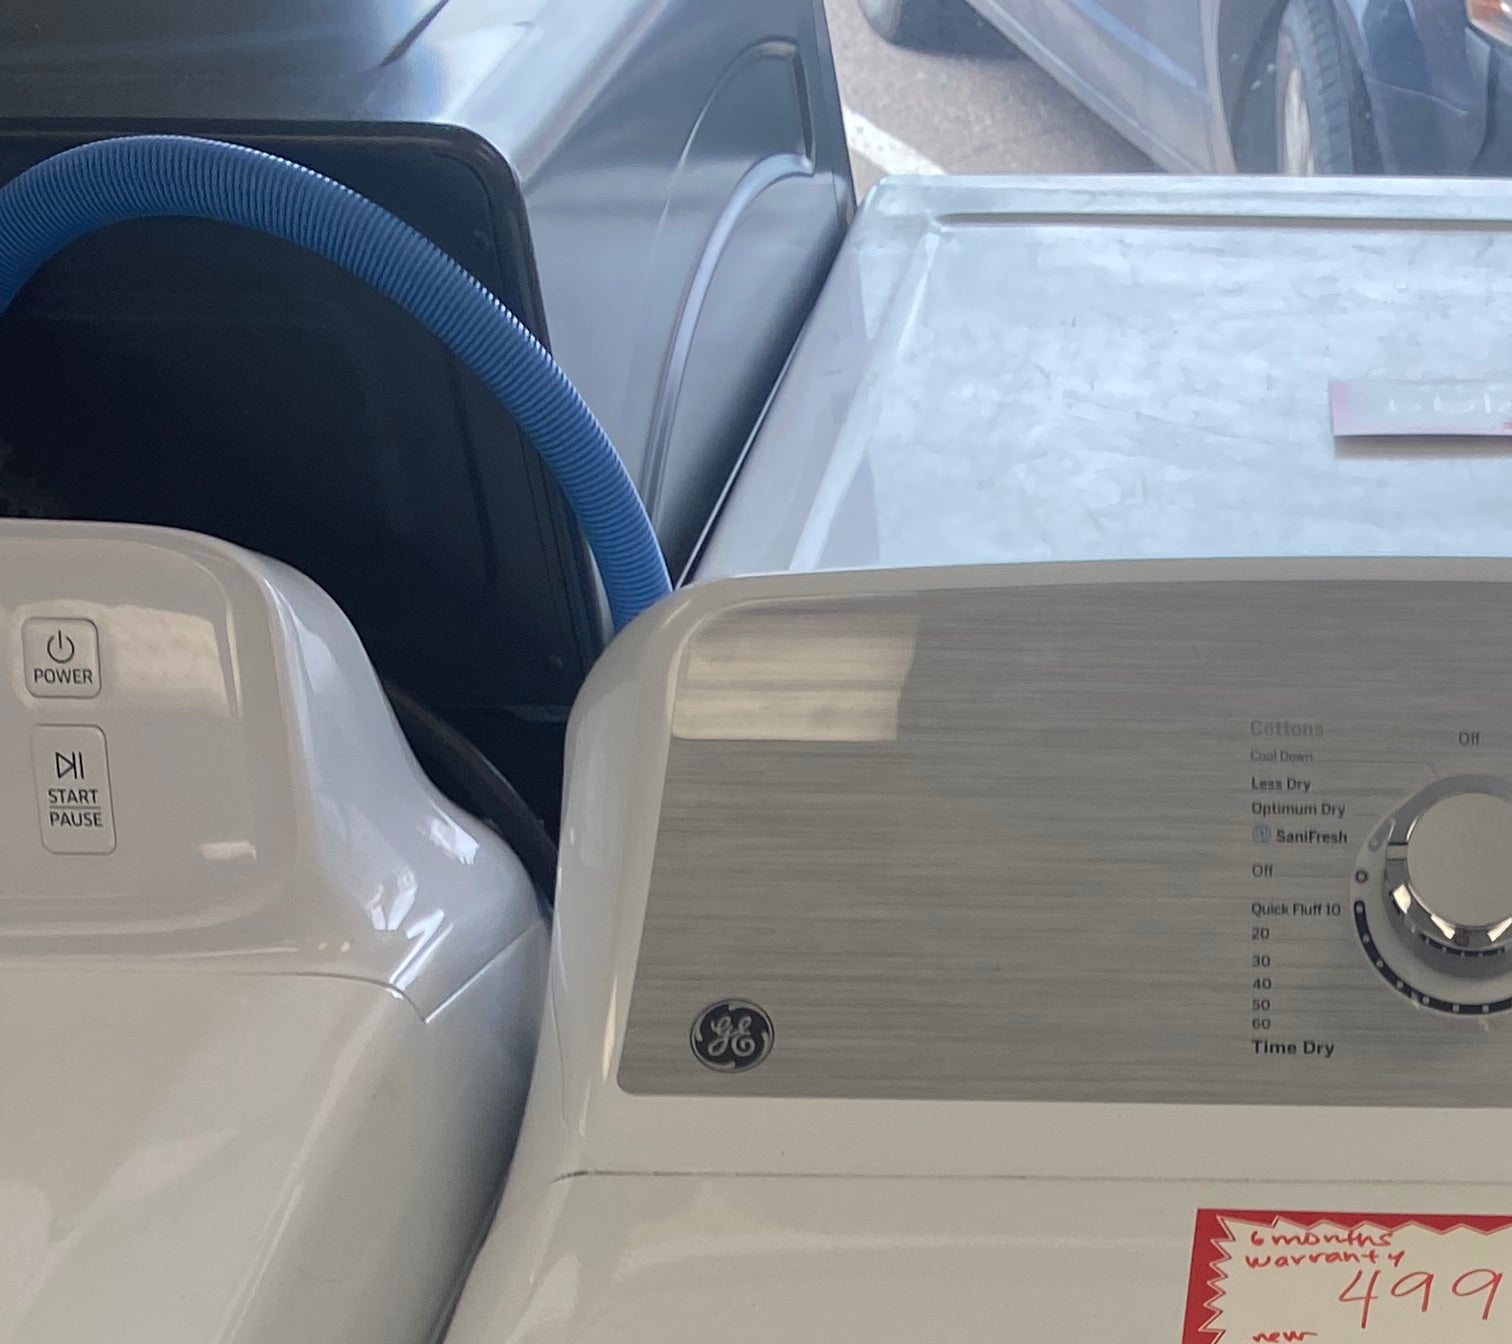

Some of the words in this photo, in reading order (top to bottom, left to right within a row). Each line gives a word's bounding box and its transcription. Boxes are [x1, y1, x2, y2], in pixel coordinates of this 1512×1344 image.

[34, 668, 93, 684] POWER
[1250, 720, 1324, 737] Cottons
[1458, 731, 1480, 747] Off
[1251, 776, 1282, 790] Less
[1287, 777, 1311, 792] Dry
[48, 788, 98, 804] START
[1252, 802, 1317, 818] Optimum
[1322, 803, 1345, 819] Dry
[50, 811, 103, 828] PAUSE
[1276, 829, 1347, 844] SaniFresh
[1252, 864, 1273, 877] Off
[1251, 902, 1289, 918] Quick
[1293, 903, 1322, 916] Fluff
[1325, 903, 1341, 916] 10
[1251, 927, 1270, 940] 20
[1252, 955, 1271, 968] 30
[1253, 978, 1272, 990] 40
[1252, 1000, 1270, 1012] 50
[1252, 1018, 1271, 1030] 60
[1251, 1039, 1297, 1054] Time
[1303, 1040, 1334, 1058] Dry
[1249, 1232, 1264, 1247] 6
[1338, 1267, 1504, 1329] 499
